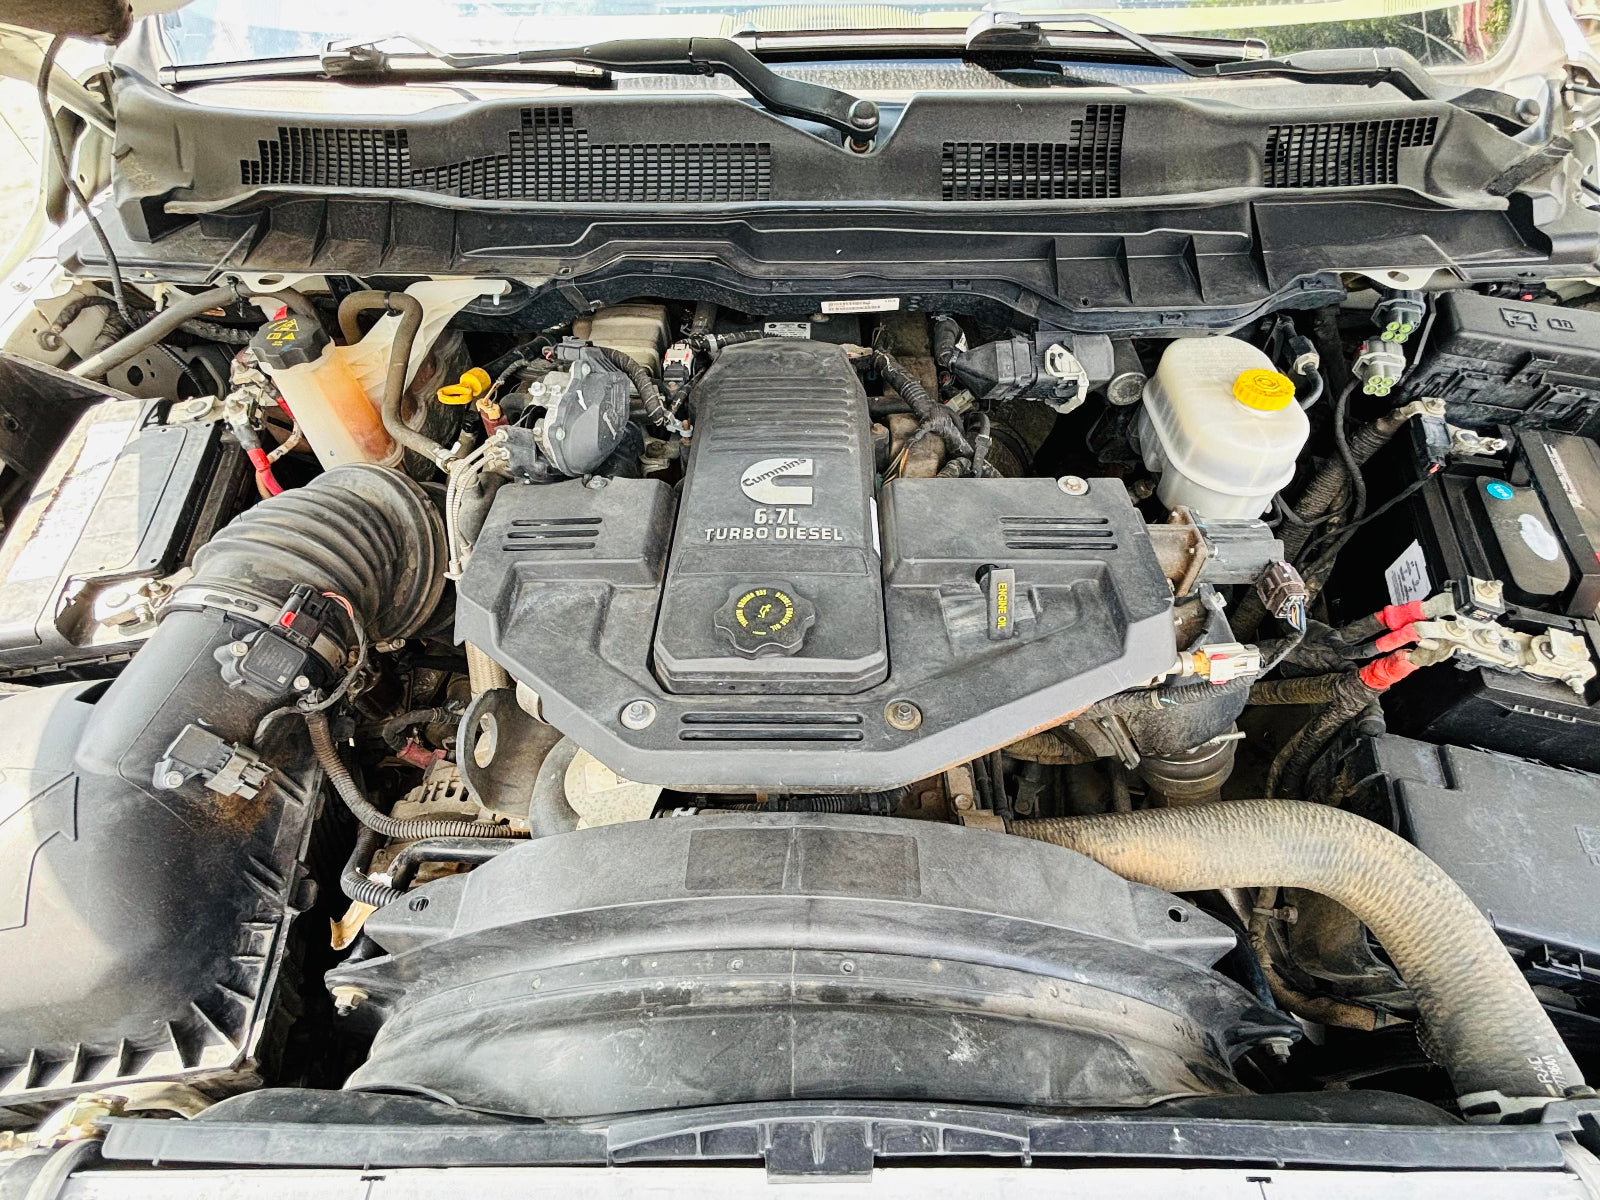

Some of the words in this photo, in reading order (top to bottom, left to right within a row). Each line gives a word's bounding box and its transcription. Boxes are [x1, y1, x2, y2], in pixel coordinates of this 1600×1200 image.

[742, 457, 807, 487] Cummins
[754, 508, 799, 526] 6.7L
[704, 527, 768, 541] TURBO
[775, 527, 843, 541] DIESEL
[997, 582, 1008, 614] ENGINE
[997, 616, 1007, 629] OIL
